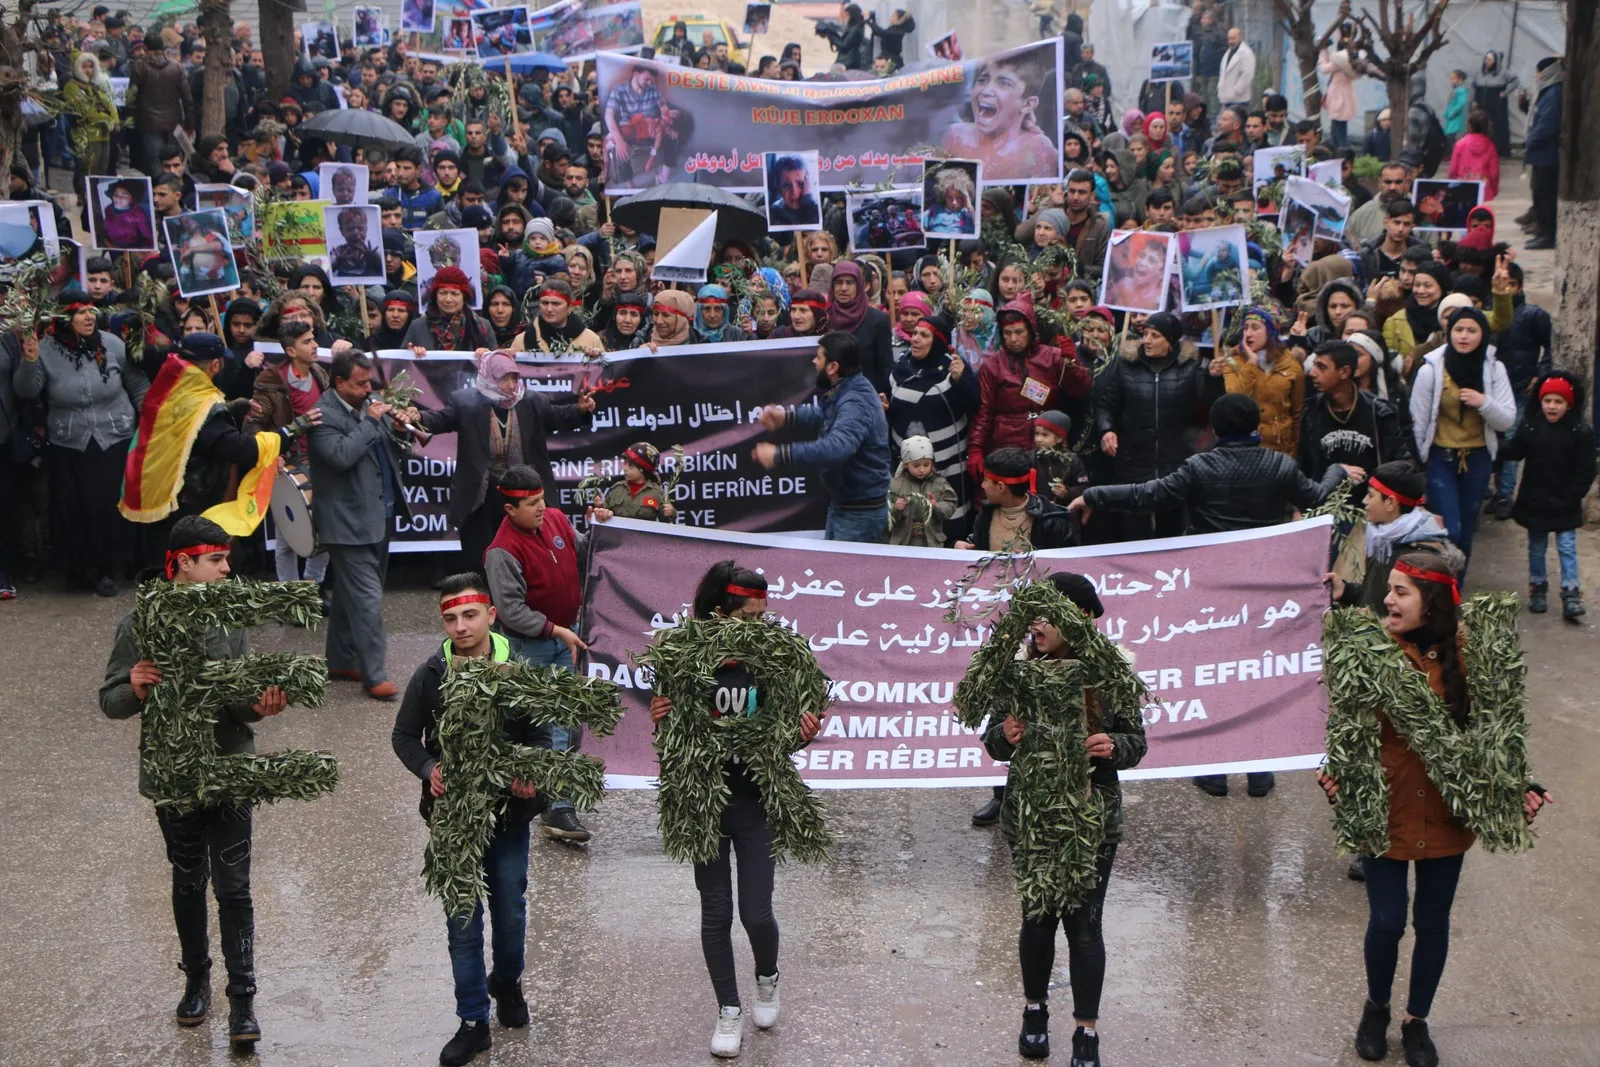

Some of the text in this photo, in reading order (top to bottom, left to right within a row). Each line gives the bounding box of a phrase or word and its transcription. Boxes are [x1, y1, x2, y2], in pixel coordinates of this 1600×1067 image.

[752, 104, 905, 125] KÛJE ERDOXAN
[834, 154, 855, 170] من
[626, 405, 683, 431] الدولة
[689, 400, 742, 428] إحتلال
[702, 475, 773, 499] EFRÎNÊ
[778, 477, 806, 495] DE
[690, 509, 716, 526] YE
[855, 575, 918, 607] على
[1084, 567, 1191, 598] الإحتلا
[1130, 603, 1249, 644] استمرار
[1256, 599, 1301, 629] هو
[808, 619, 871, 652] على
[866, 743, 983, 770] RÊBER
